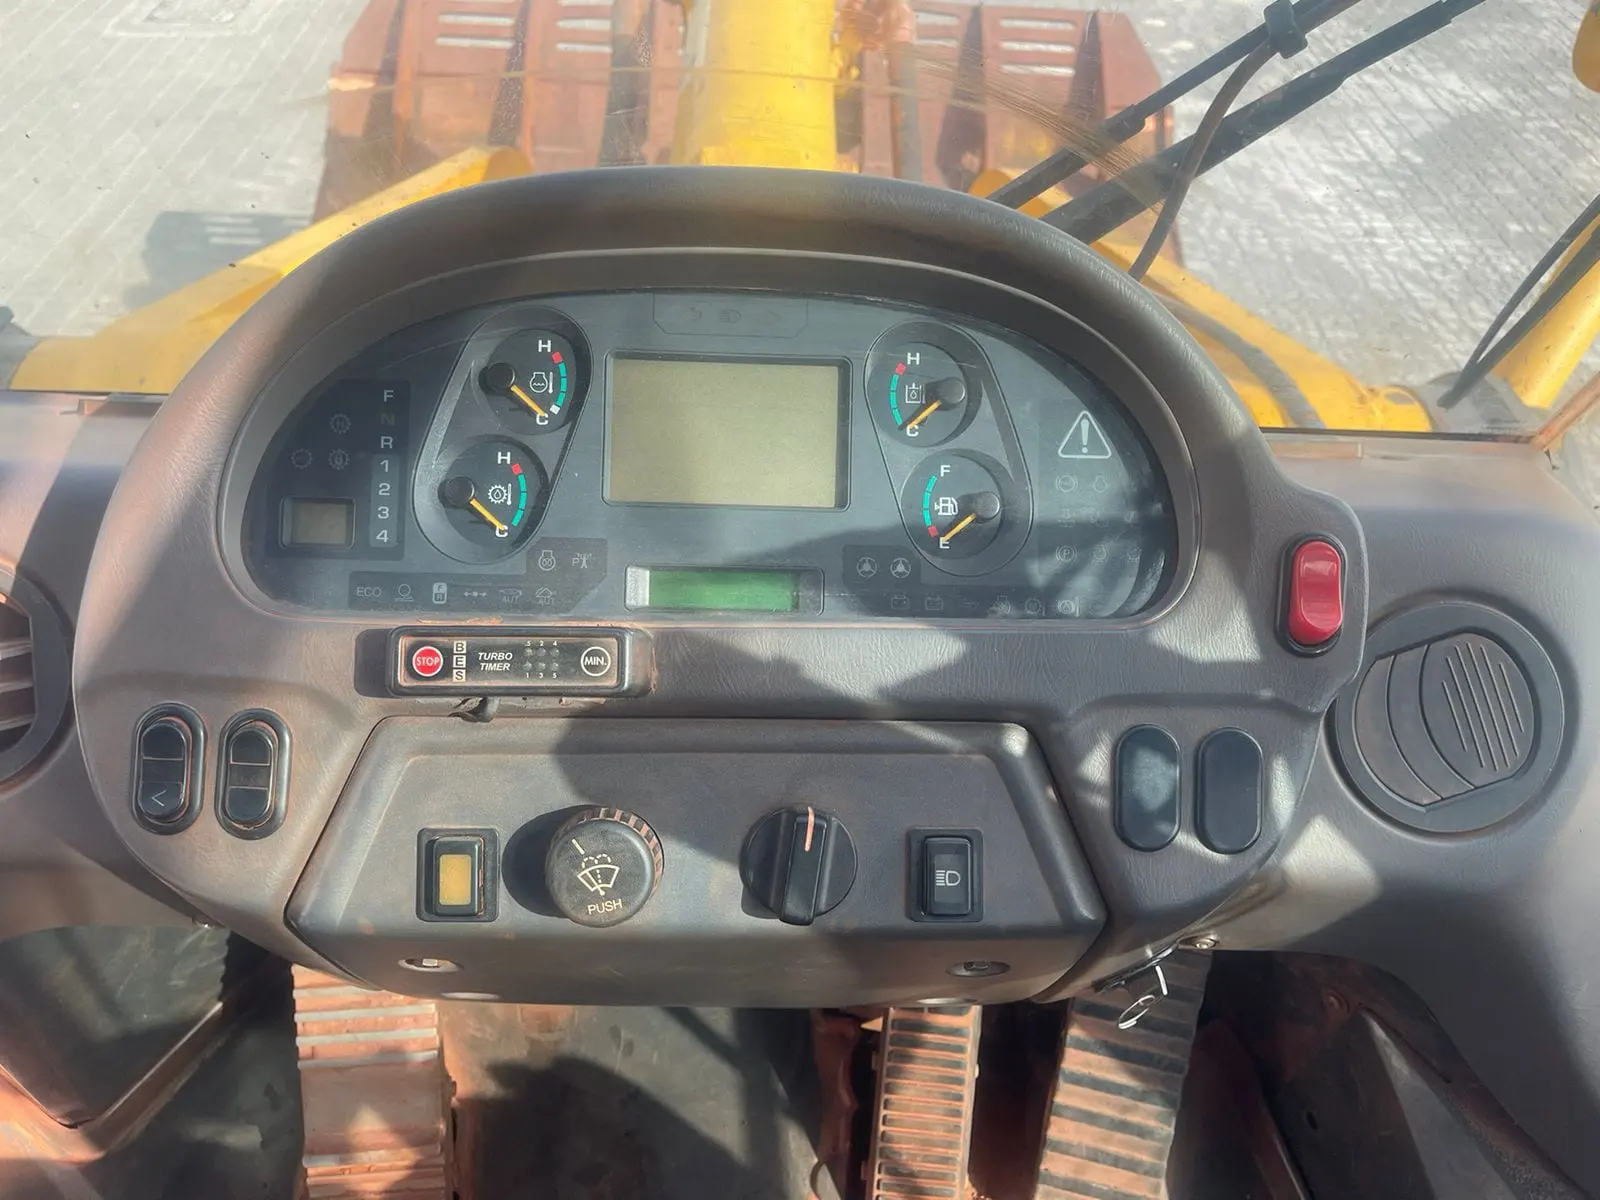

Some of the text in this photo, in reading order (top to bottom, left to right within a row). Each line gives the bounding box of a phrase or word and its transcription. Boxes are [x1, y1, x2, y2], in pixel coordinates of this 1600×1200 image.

[538, 340, 552, 353] H
[907, 352, 921, 365] H
[383, 390, 394, 402] F
[380, 413, 395, 426] N
[536, 414, 549, 426] C
[906, 425, 919, 437] C
[380, 436, 393, 449] R
[498, 452, 511, 465] H
[380, 460, 389, 473] 1
[940, 465, 951, 477] F
[378, 483, 391, 496] 2
[377, 506, 390, 519] 3
[376, 530, 389, 543] 4
[495, 525, 509, 538] C
[356, 586, 382, 597] ECO
[416, 655, 440, 667] STOP
[478, 652, 513, 661] TURBO
[584, 656, 608, 667] MIN.
[480, 662, 511, 671] TIMER
[587, 898, 623, 915] PUSH
